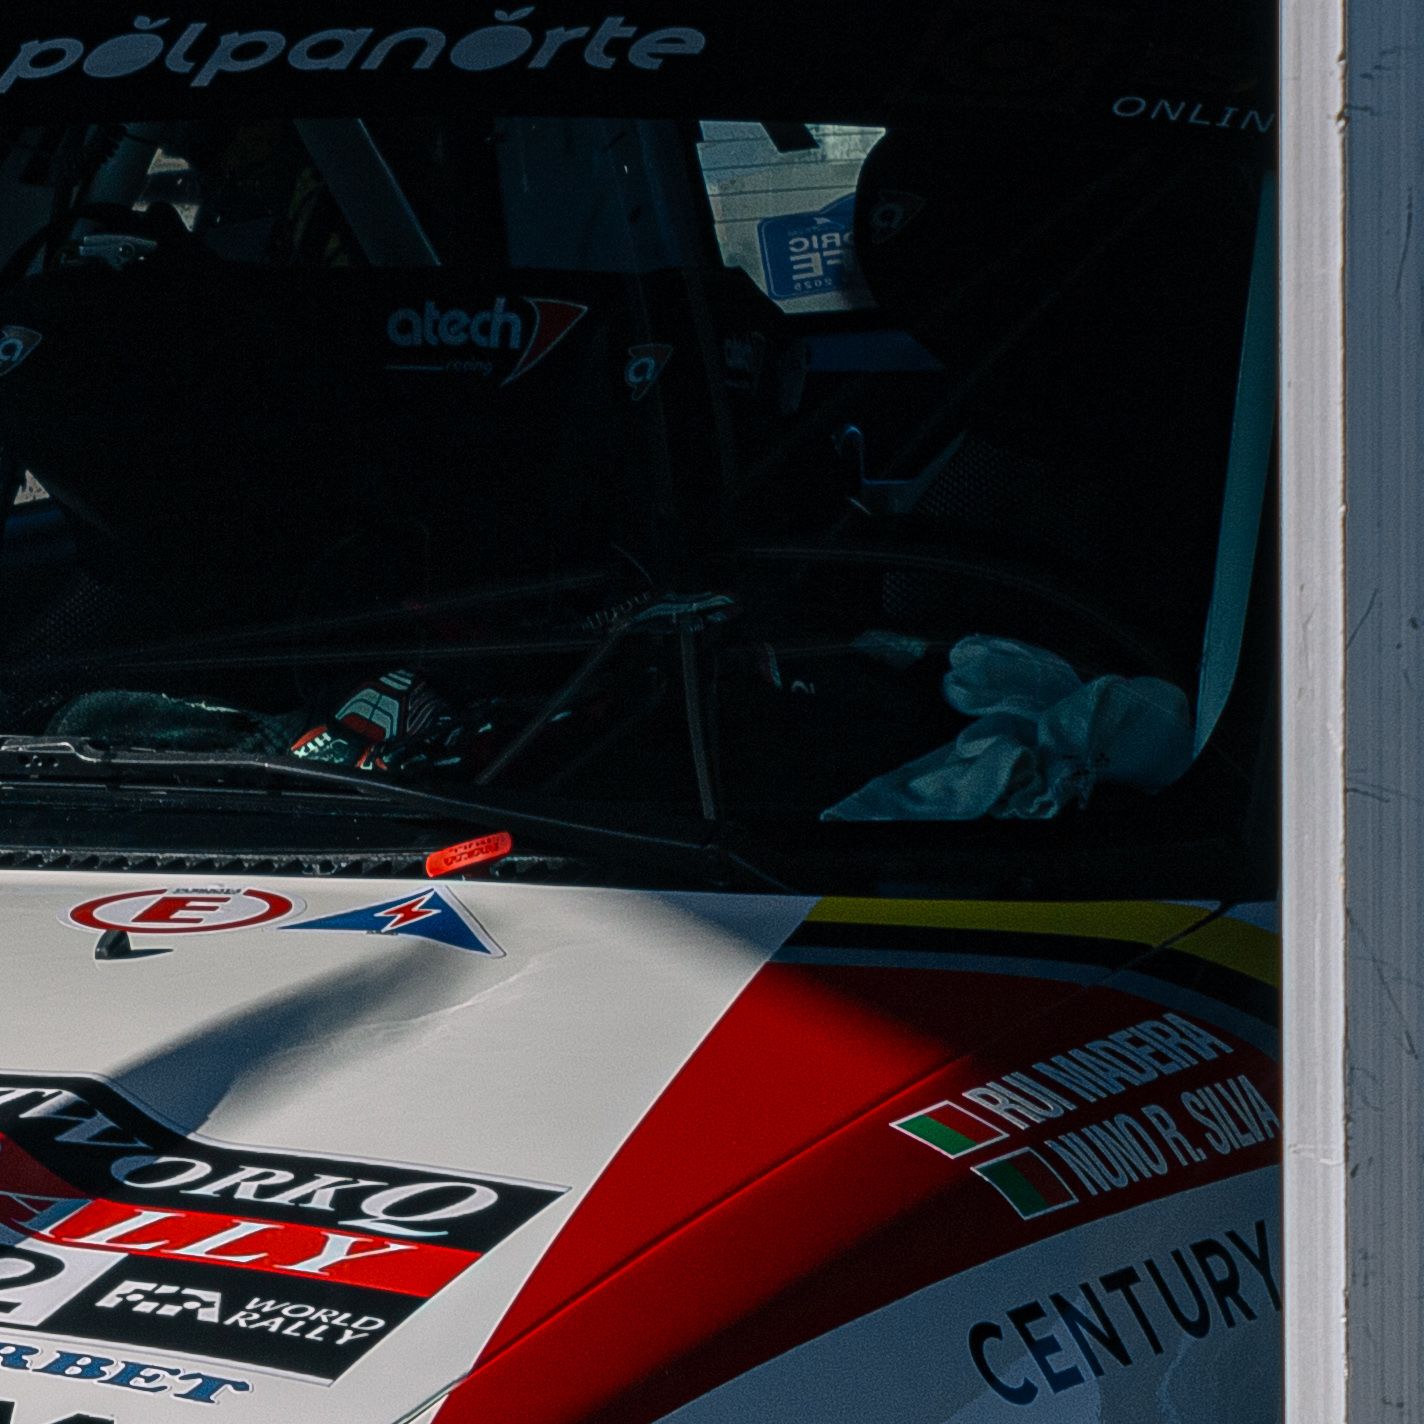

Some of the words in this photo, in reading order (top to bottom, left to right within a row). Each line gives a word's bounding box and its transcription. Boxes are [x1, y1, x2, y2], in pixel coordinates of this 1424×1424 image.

[386, 295, 523, 350] atech
[130, 896, 231, 924] E
[971, 1062, 1073, 1131] RUI
[1048, 1011, 1234, 1111] MADEIRA
[1046, 1115, 1167, 1196] NUNO
[1157, 1104, 1207, 1165] R.
[222, 1308, 372, 1347] RALLY
[243, 1294, 386, 1332] WORLD
[968, 1219, 1282, 1407] CENTURY
